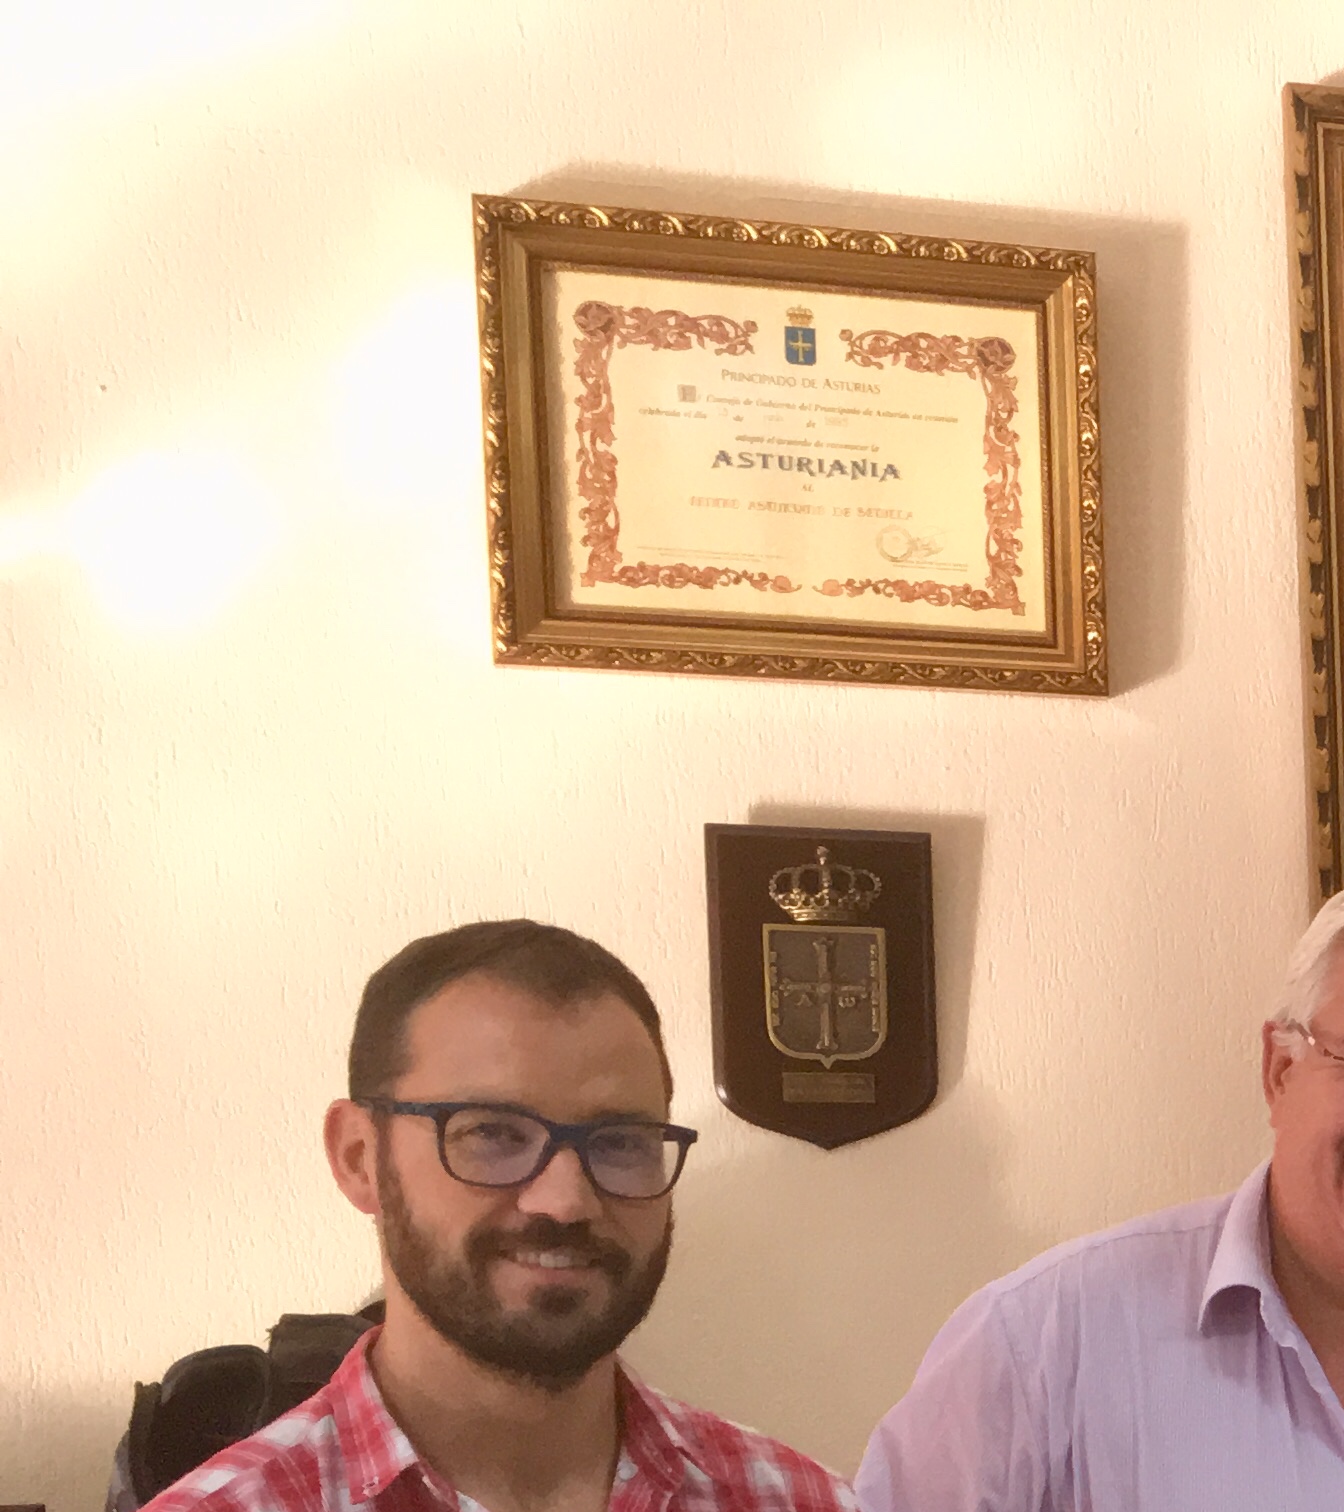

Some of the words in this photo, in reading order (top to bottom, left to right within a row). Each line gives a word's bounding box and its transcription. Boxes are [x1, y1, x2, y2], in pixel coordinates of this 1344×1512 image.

[802, 377, 818, 389] DE
[823, 378, 881, 394] ASTURIAS
[711, 449, 902, 483] ASTURIANIA
